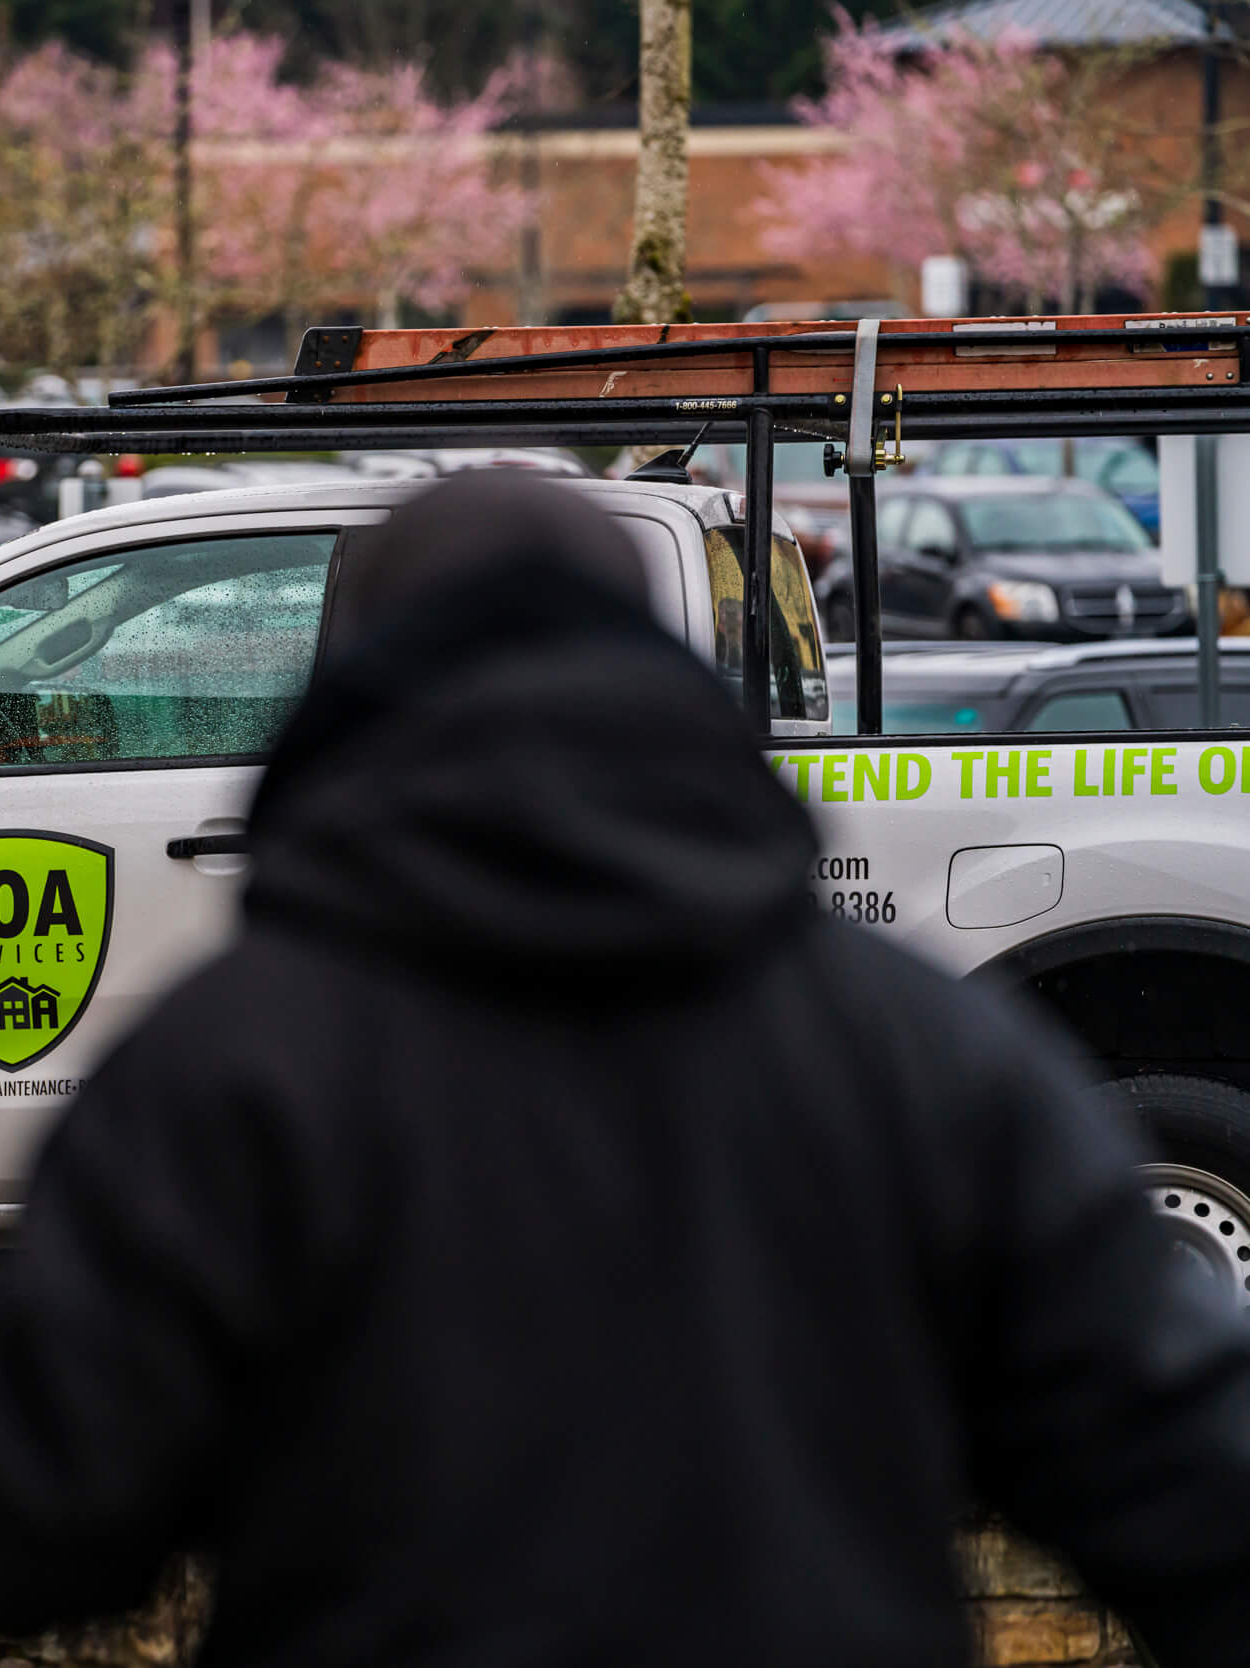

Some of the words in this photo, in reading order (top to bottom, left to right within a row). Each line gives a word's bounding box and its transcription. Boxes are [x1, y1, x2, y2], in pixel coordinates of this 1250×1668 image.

[675, 400, 737, 410] 1-800-445-7666
[951, 751, 1053, 799] THE
[1074, 747, 1178, 797] LIFE
